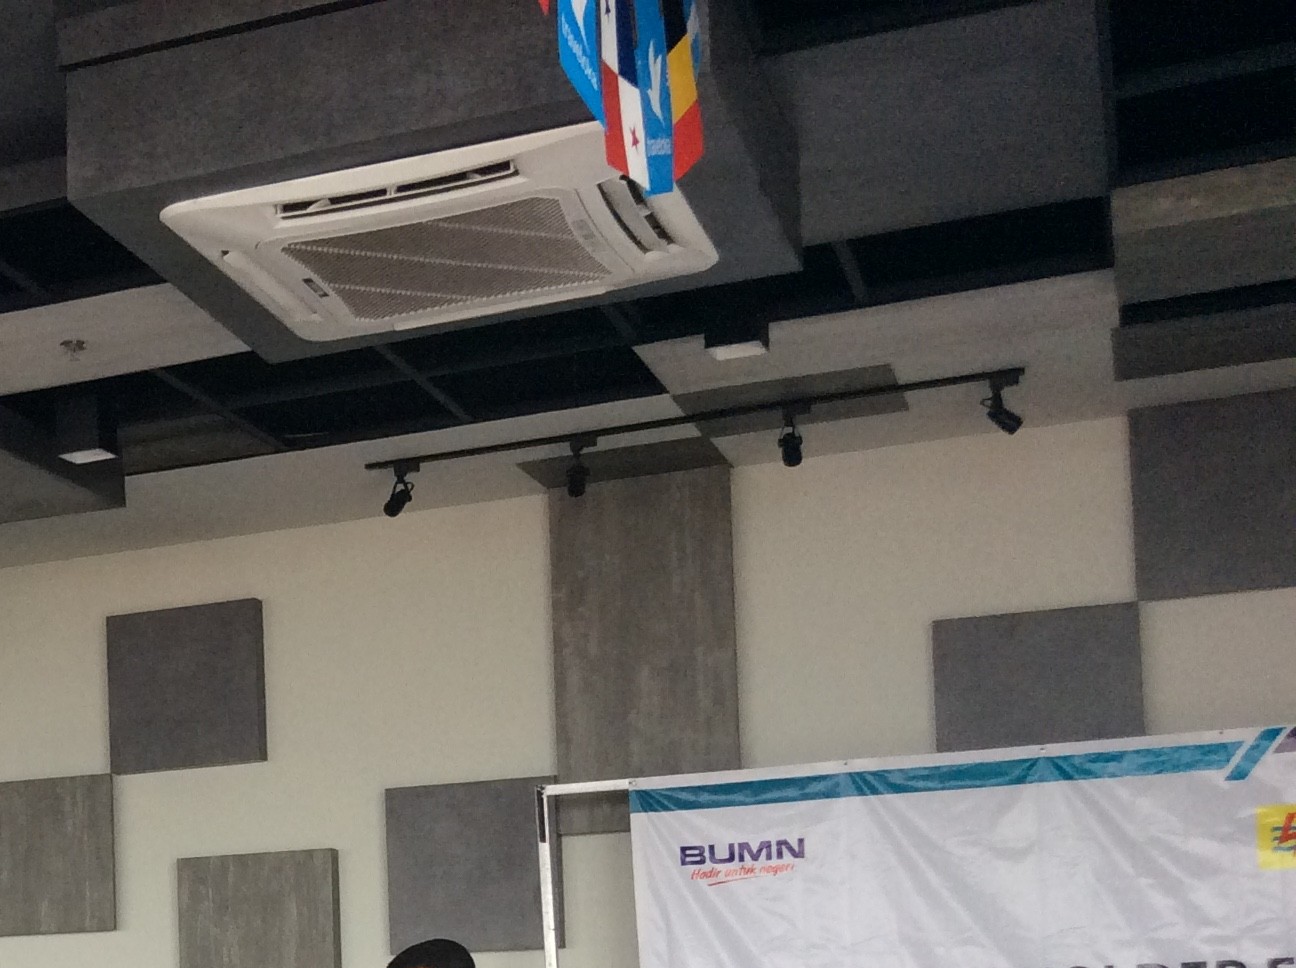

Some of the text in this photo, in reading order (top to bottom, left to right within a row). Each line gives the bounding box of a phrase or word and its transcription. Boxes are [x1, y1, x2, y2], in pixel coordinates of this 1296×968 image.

[680, 838, 805, 866] BUMN
[690, 867, 721, 880] Hadir
[724, 864, 756, 877] untuk
